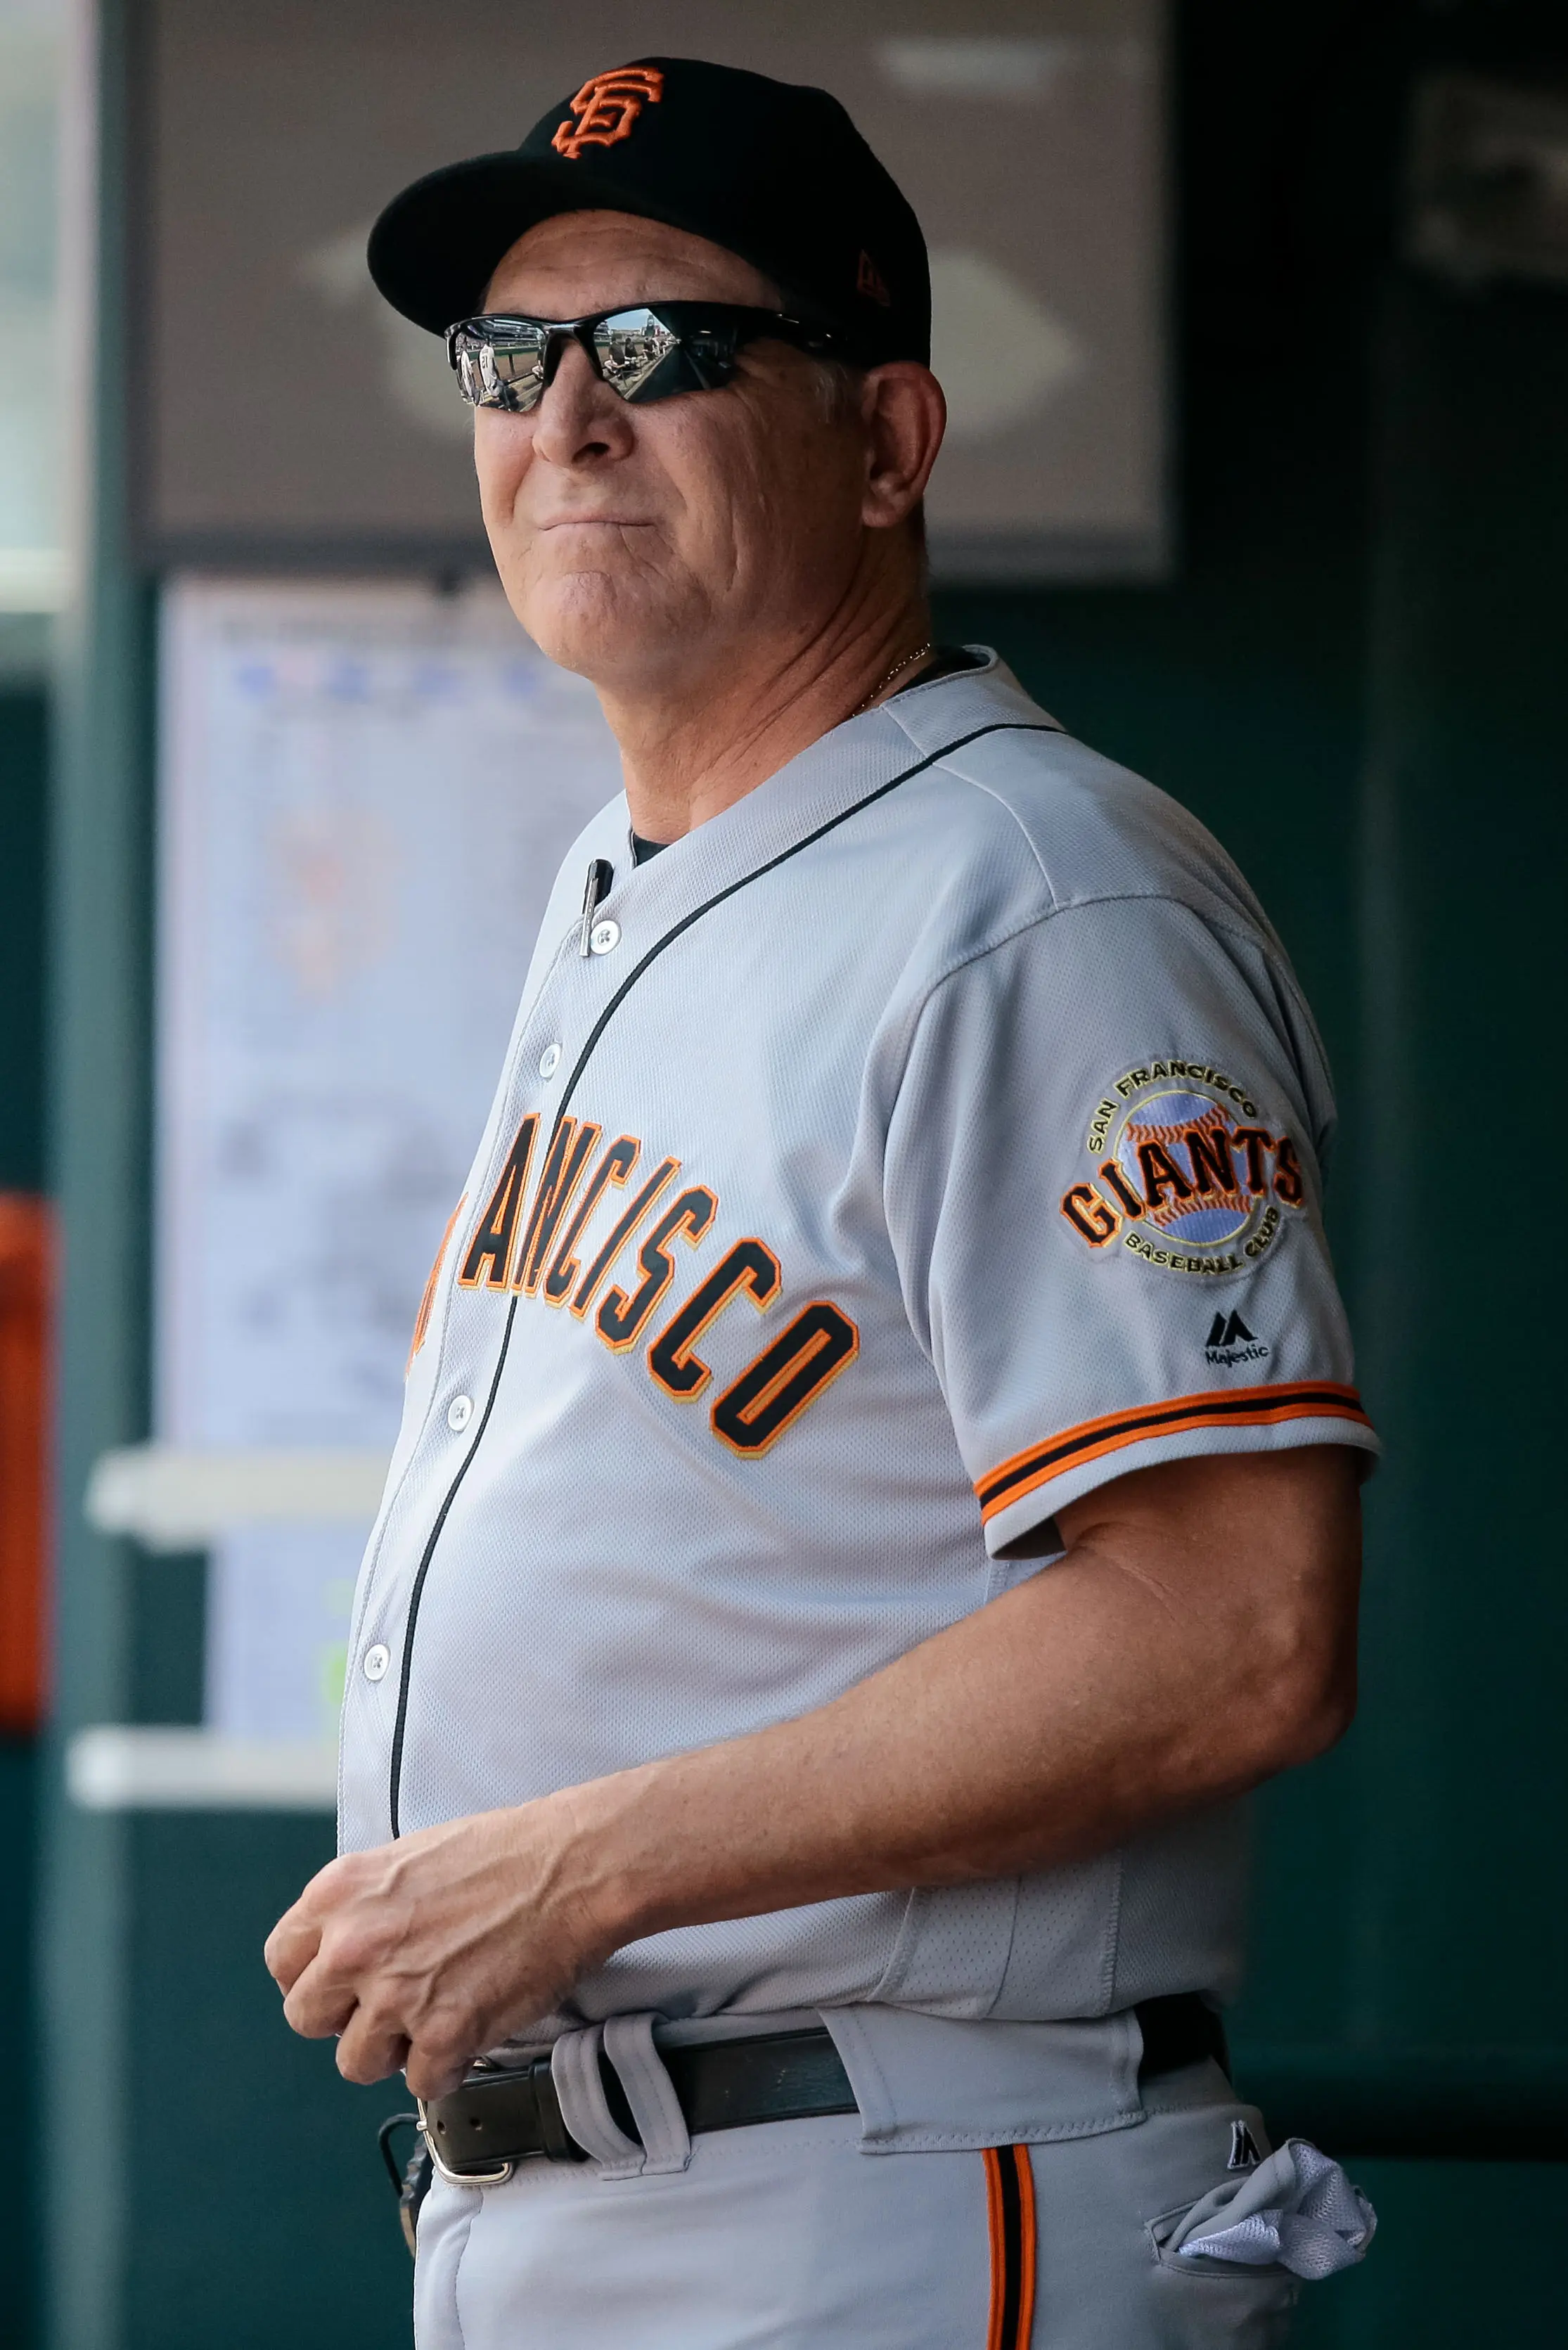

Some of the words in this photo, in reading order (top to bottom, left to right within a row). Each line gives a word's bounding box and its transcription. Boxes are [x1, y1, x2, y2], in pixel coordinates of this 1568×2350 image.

[551, 68, 664, 159] SF
[1087, 1097, 1120, 1154] SAN
[1113, 1060, 1257, 1119] FRANCISCO
[1060, 1126, 1304, 1247] GIANTS
[406, 1112, 860, 1460] ANCISCO
[1124, 1232, 1245, 1274] BASEBALL
[1243, 1207, 1279, 1258] CLUB
[1205, 1346, 1269, 1368] Majestic
